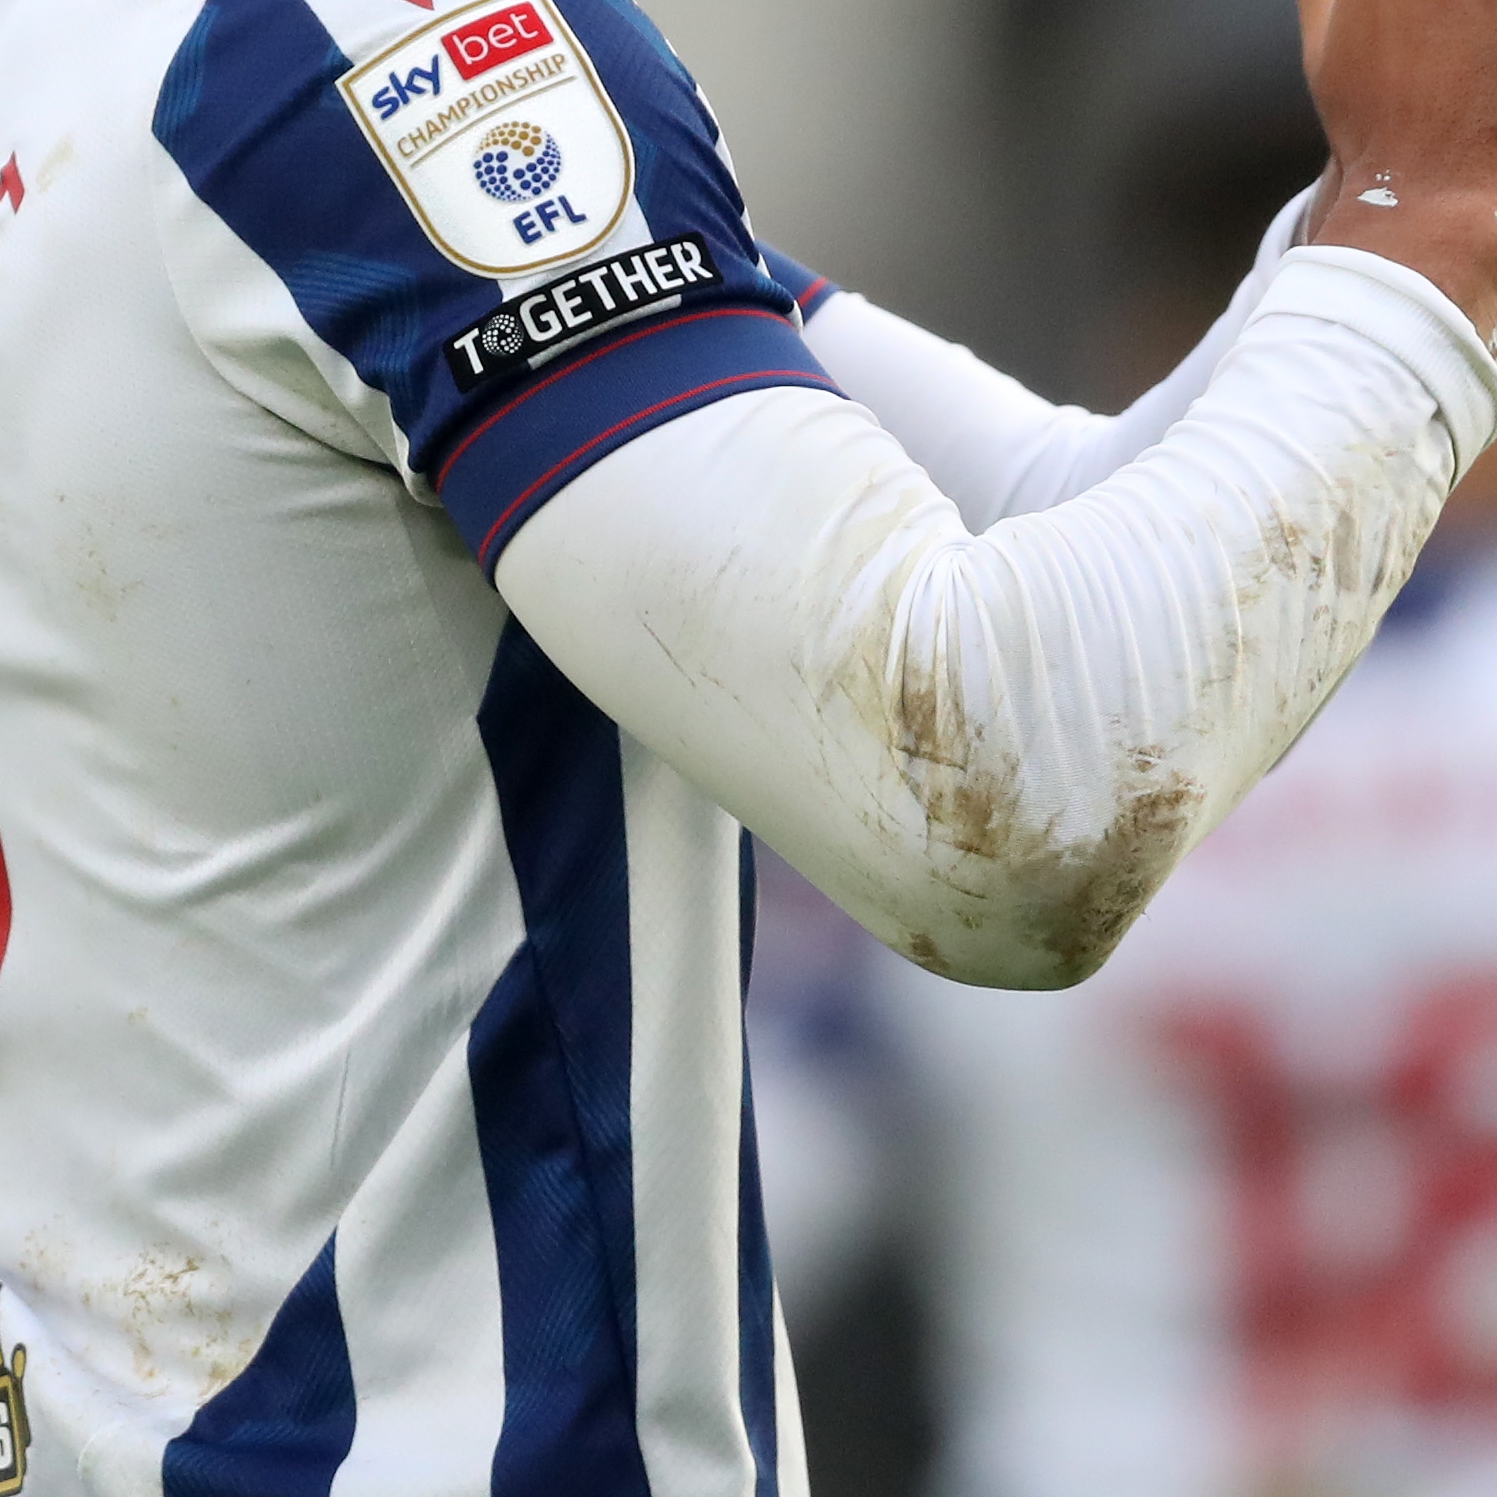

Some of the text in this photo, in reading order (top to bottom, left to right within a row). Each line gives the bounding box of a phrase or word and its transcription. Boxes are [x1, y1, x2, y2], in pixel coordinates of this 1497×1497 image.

[371, 11, 539, 120] sky bet
[397, 53, 568, 158] CHAMPIONSHIP
[513, 196, 587, 245] EFL
[453, 241, 713, 376] TOGETHER
